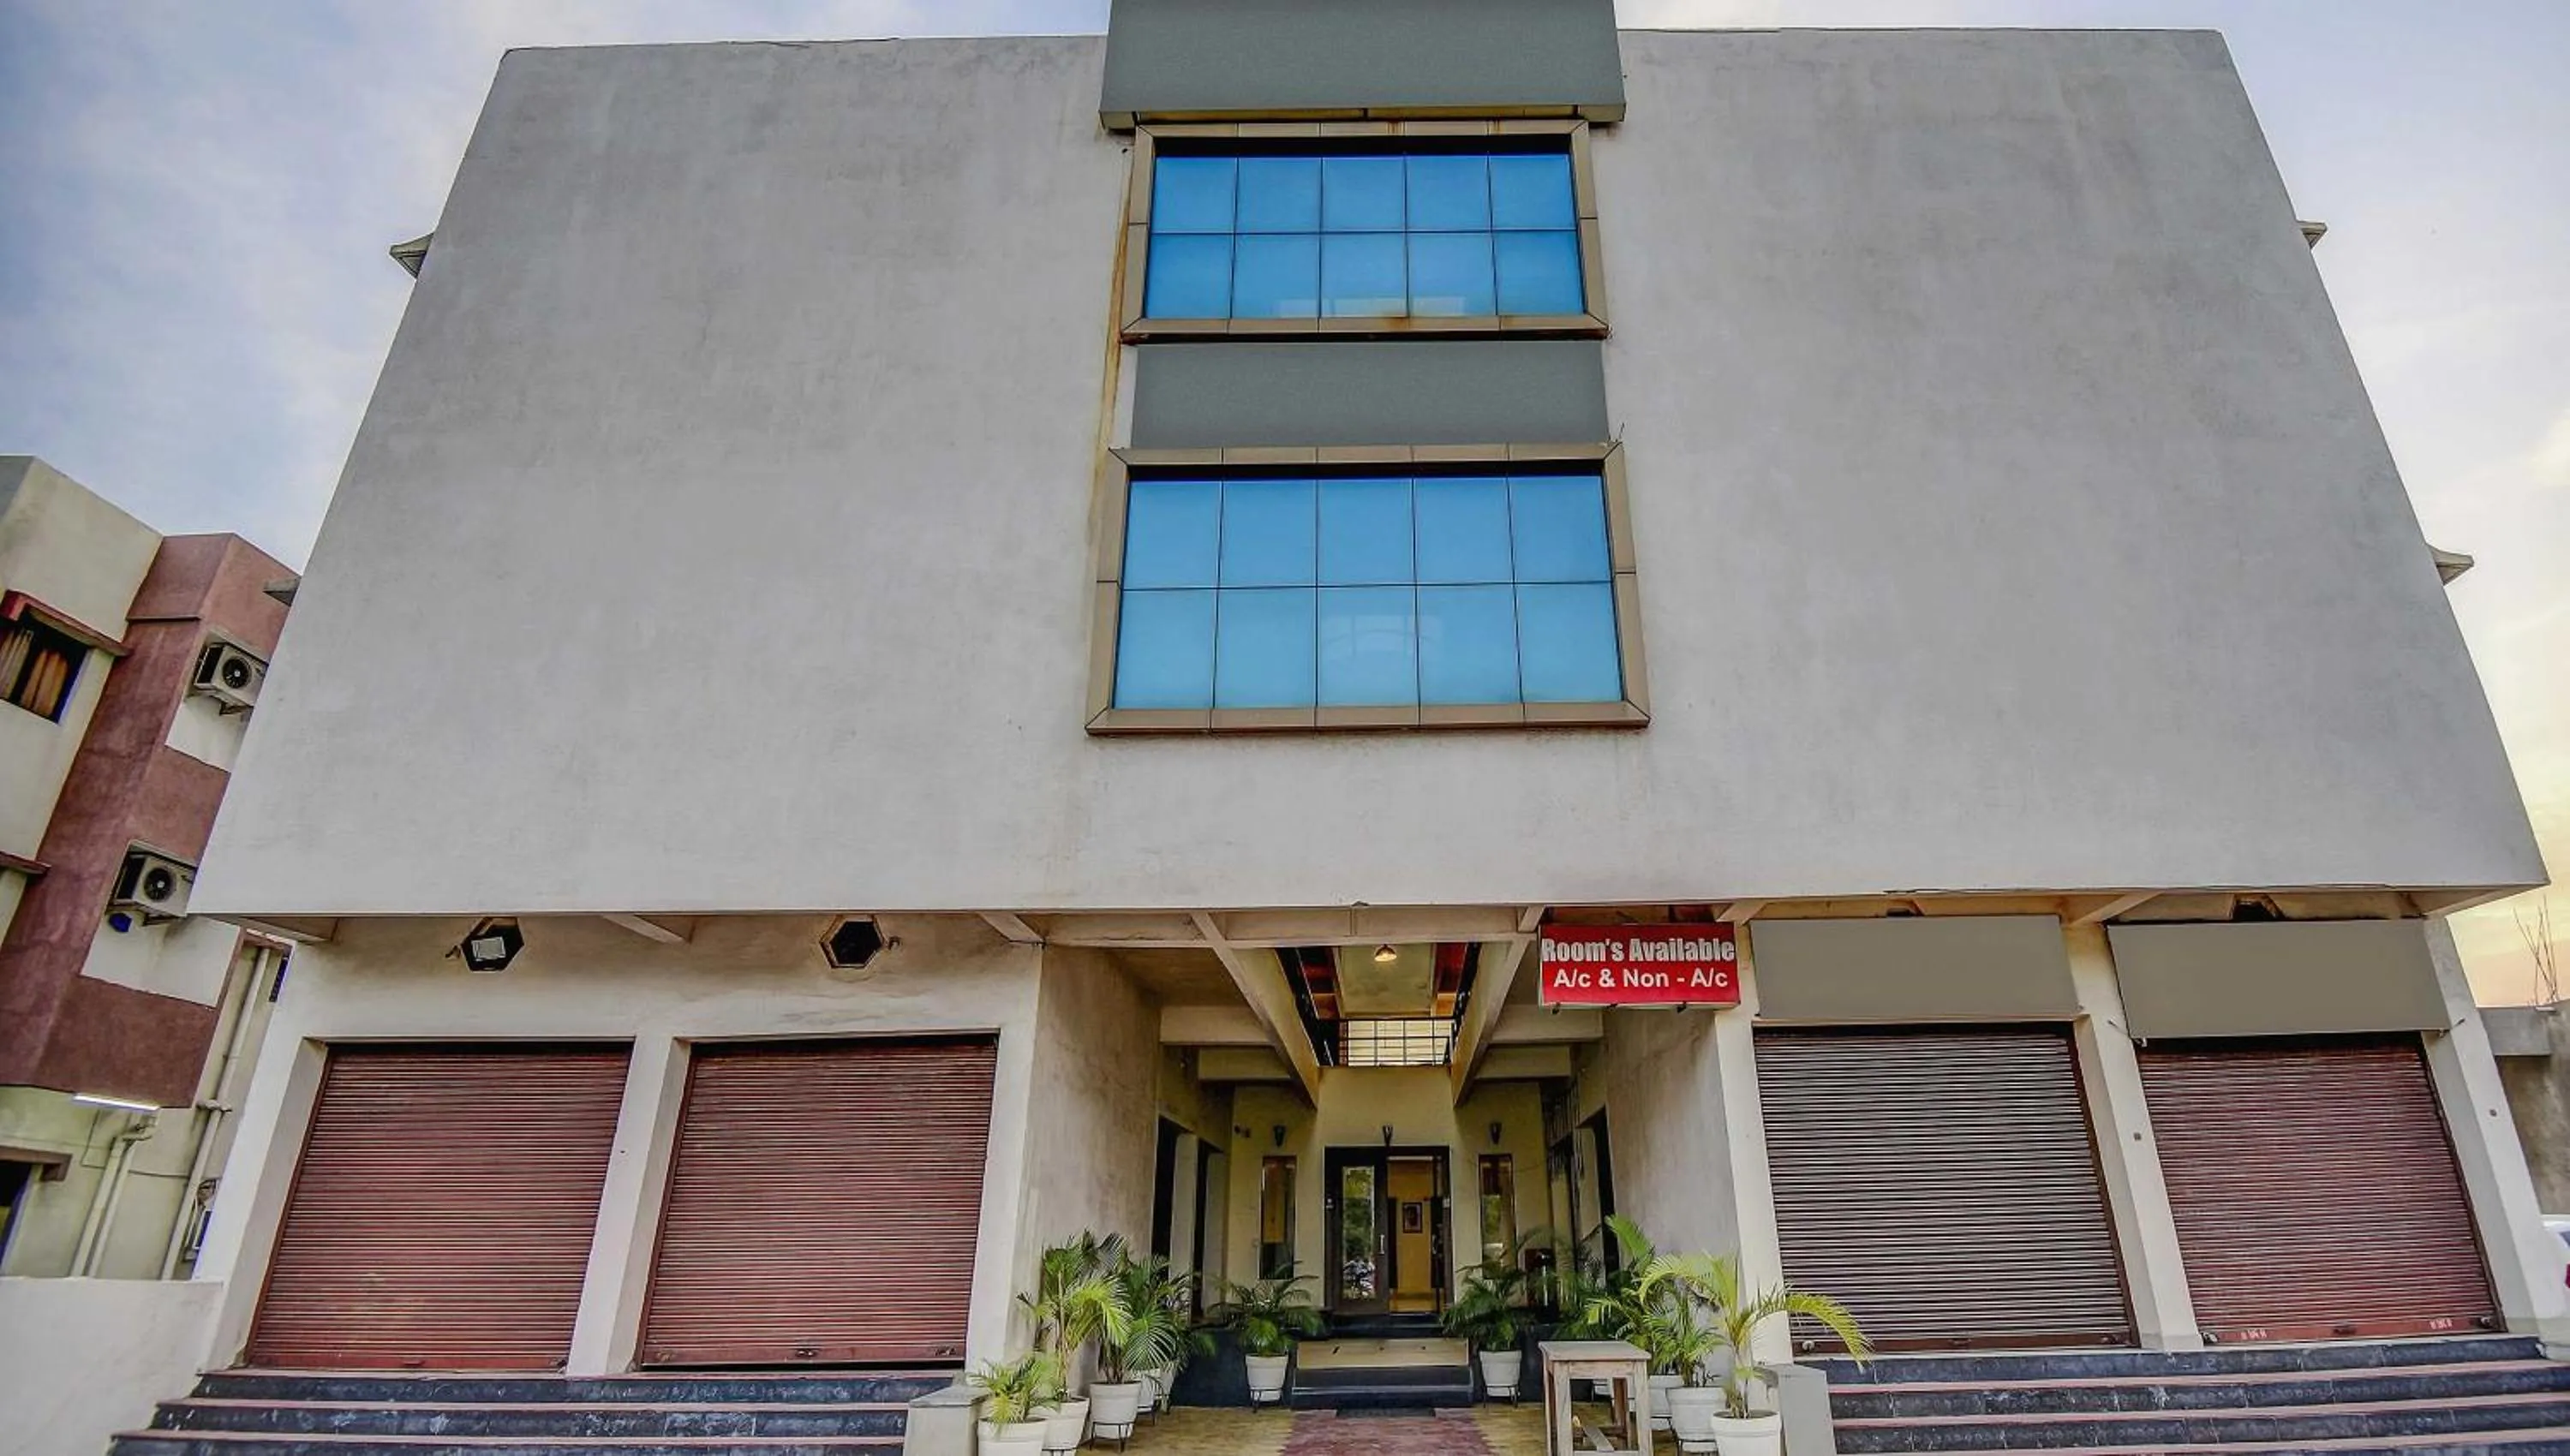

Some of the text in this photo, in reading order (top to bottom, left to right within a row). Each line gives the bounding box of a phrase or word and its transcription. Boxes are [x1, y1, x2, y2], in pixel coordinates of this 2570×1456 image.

[1541, 938, 1735, 962] Room's Available
[1553, 969, 1591, 988] A/c
[1599, 969, 1616, 988] &
[1623, 969, 1669, 988] Non
[1690, 968, 1728, 988] A/c
